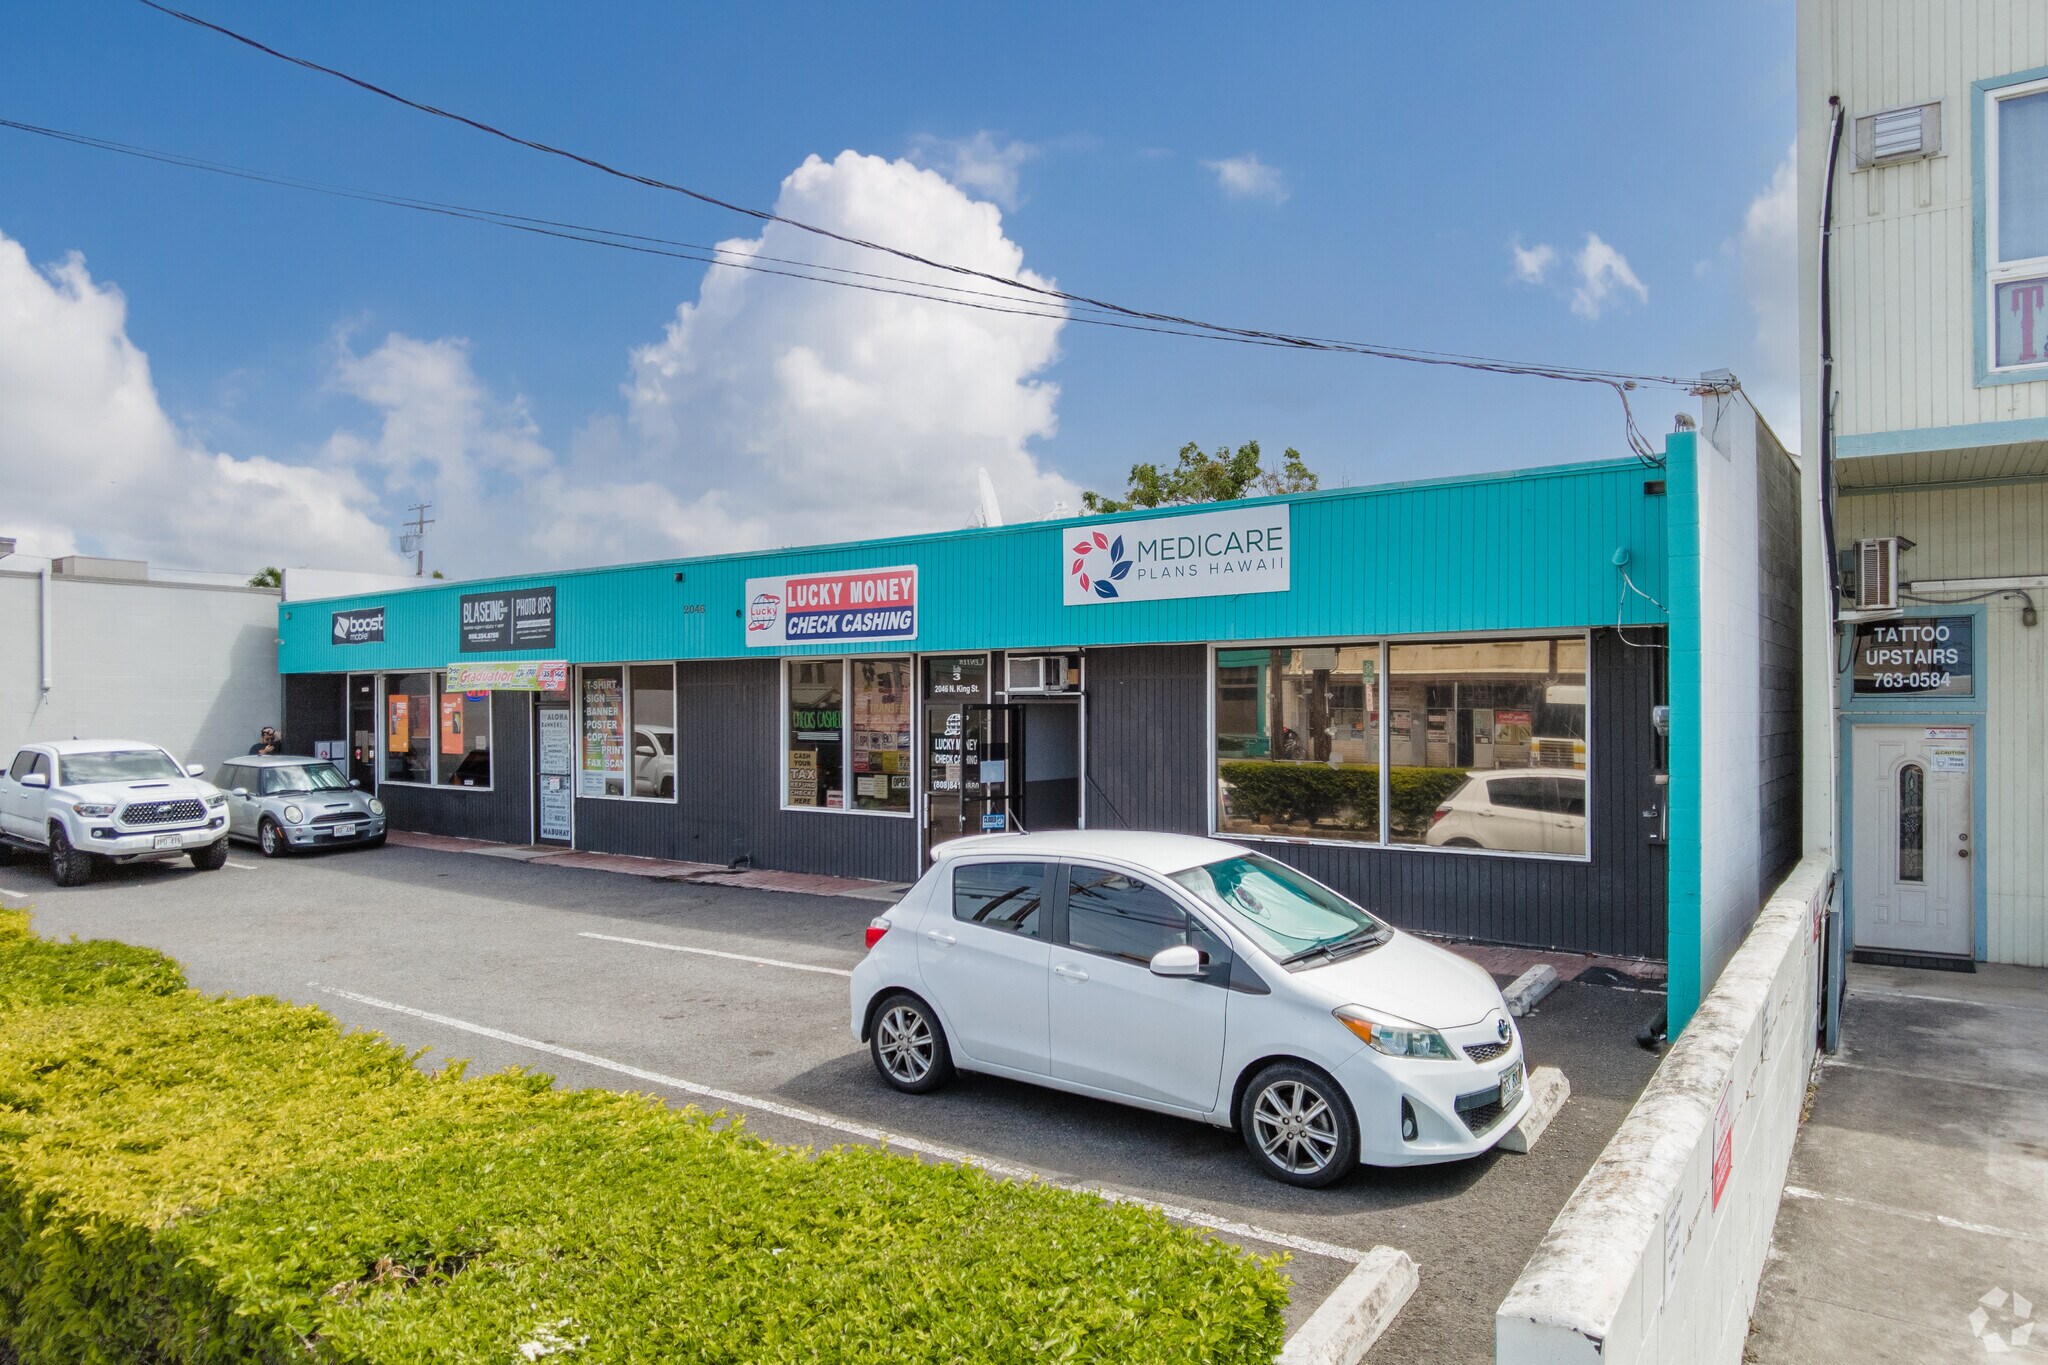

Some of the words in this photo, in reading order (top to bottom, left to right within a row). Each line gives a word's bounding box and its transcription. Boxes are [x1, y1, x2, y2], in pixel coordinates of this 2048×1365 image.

[1138, 527, 1283, 562] MEDICARE
[1138, 565, 1198, 580] PLANS
[1209, 557, 1284, 575] HAWAII
[788, 583, 842, 607] LUCKY
[850, 577, 912, 603] MONEY
[516, 598, 537, 616] PHOTO
[538, 596, 552, 614] OPS
[683, 604, 705, 614] 2046
[751, 607, 777, 616] Lucky
[349, 613, 384, 633] boost
[788, 615, 839, 635] CHECK
[841, 610, 912, 632] CASHING
[349, 632, 368, 641] mobile
[1873, 626, 1951, 643] TATTOO
[1865, 649, 1959, 666] UPSTAIRS
[461, 669, 514, 683] Graduation
[952, 672, 961, 681] 3
[1872, 672, 1952, 688] 763-0584
[586, 680, 616, 690] T-SHIRT
[934, 685, 949, 693] 2046
[956, 685, 970, 695] King
[971, 684, 980, 692] St.
[586, 693, 605, 703] SIGN
[586, 707, 619, 716] BANNER
[547, 713, 569, 721] ALOHA
[586, 720, 618, 730] POSTER
[586, 732, 608, 742] COPY
[934, 738, 954, 751] LUCKY
[586, 759, 601, 768] FAX
[935, 754, 953, 764] CHECK
[790, 768, 815, 780] TAX
[790, 781, 816, 789] REFUND
[542, 828, 570, 837] MABUHAY
